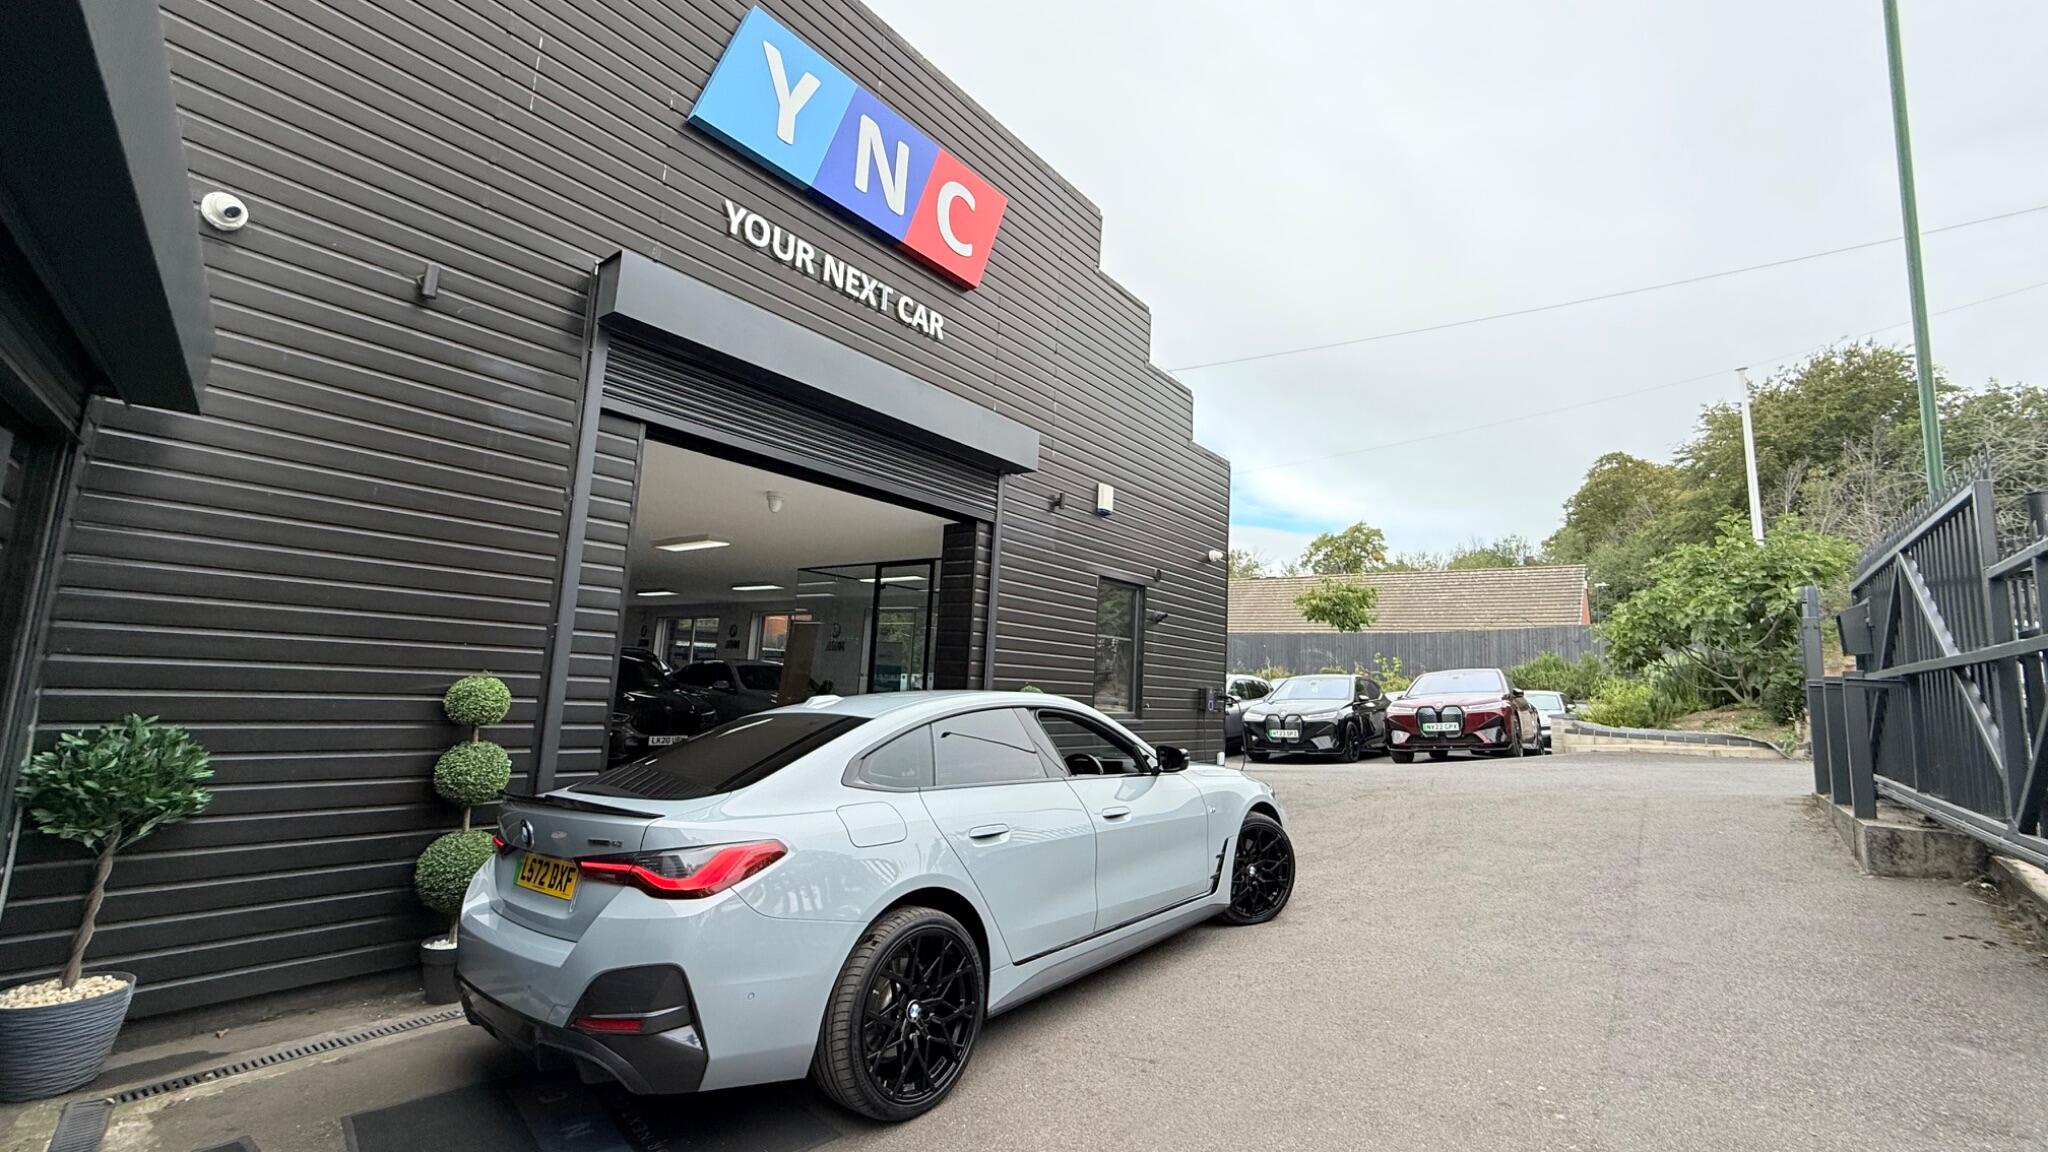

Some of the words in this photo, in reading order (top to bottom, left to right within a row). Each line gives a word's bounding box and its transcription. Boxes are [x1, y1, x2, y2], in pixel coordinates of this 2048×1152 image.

[724, 199, 815, 274] YOUR
[823, 254, 894, 311] NEXT
[898, 296, 945, 340] CAR
[520, 855, 550, 887] LS72
[547, 863, 577, 893] DXF
